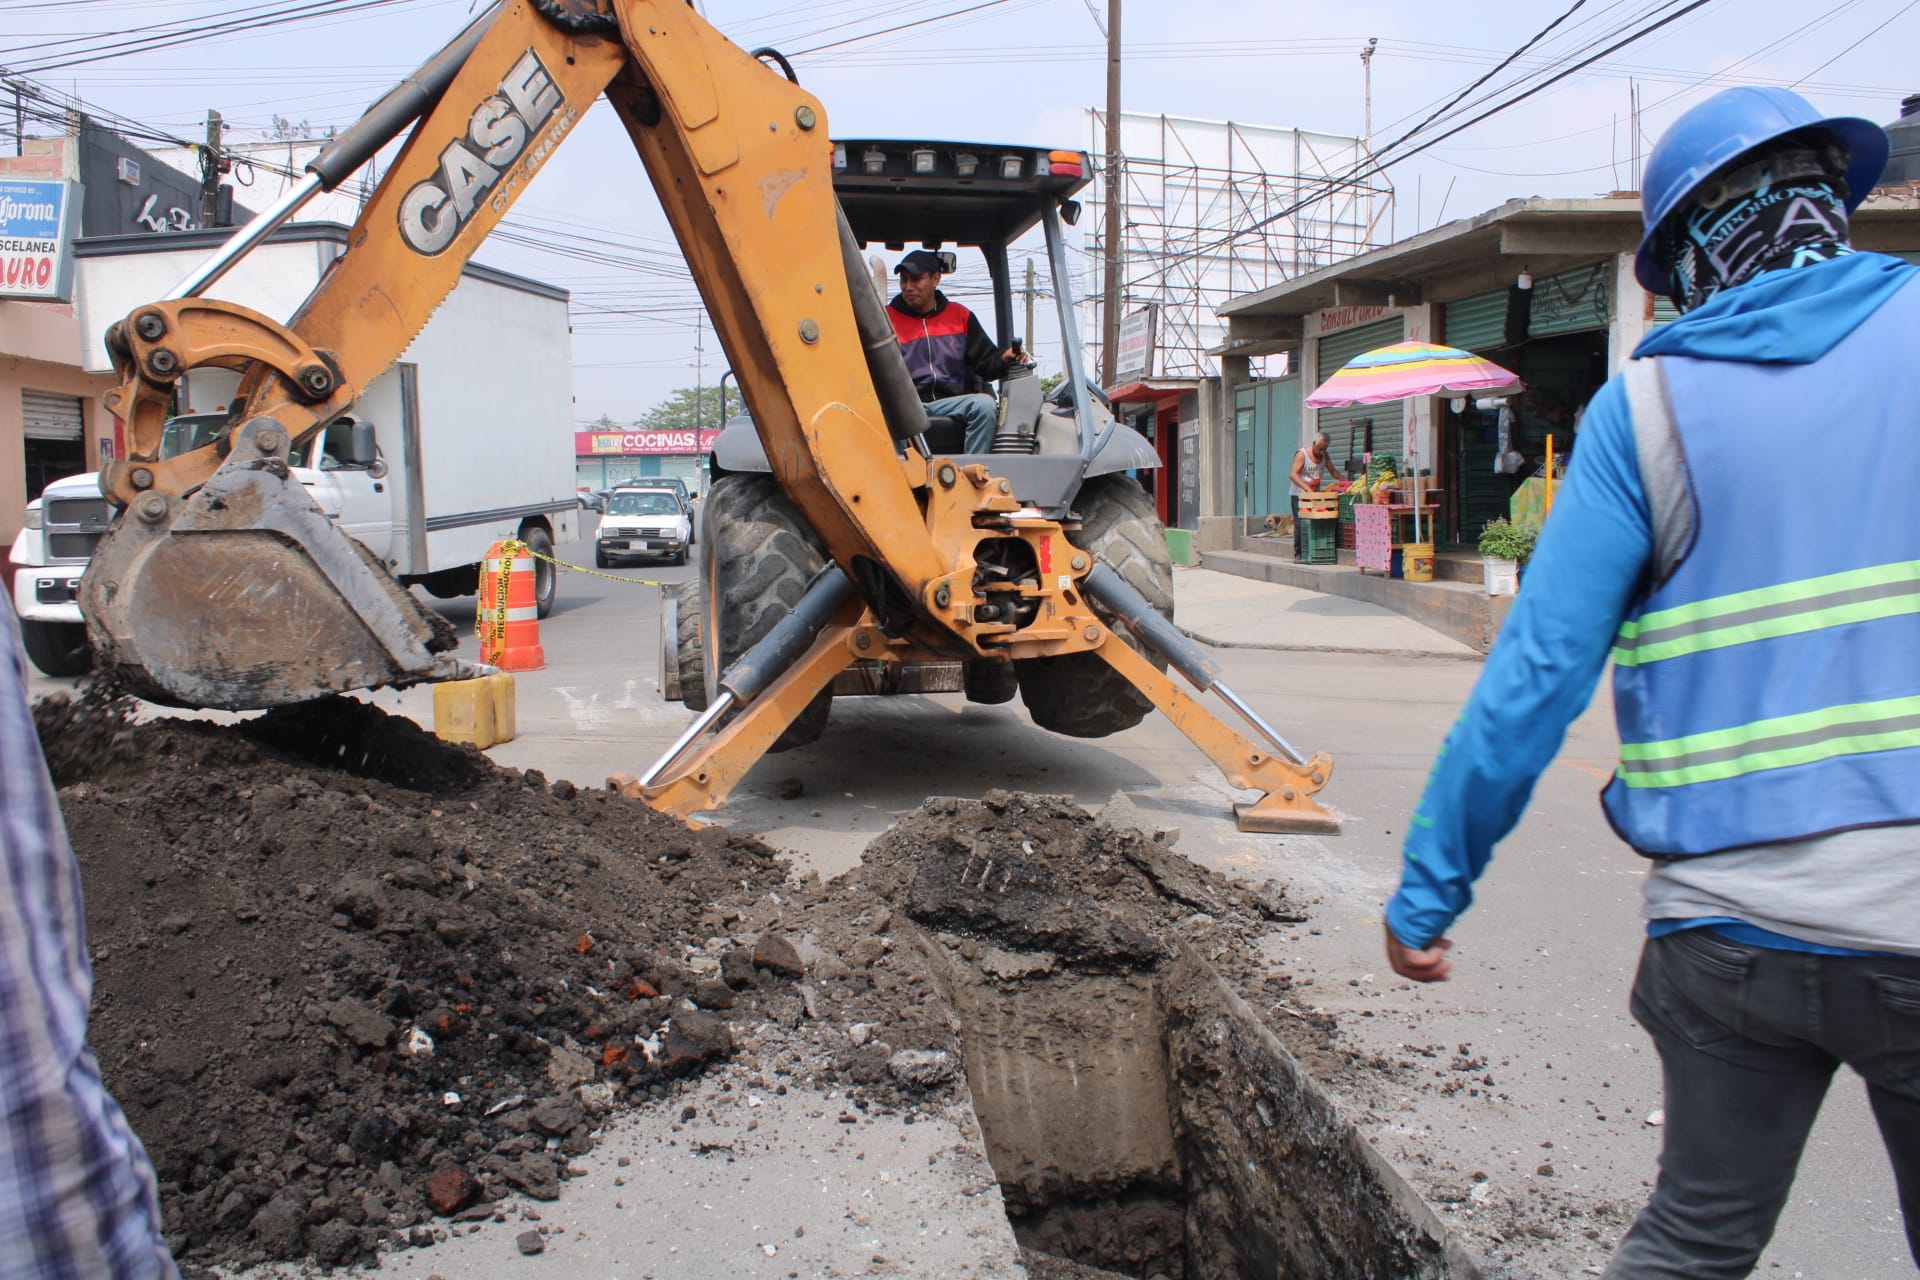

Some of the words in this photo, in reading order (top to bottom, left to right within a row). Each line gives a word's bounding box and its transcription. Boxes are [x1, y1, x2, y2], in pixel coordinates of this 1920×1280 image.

[397, 46, 565, 258] CASE
[0, 195, 54, 227] Corona
[624, 433, 696, 447] COCINAS
[497, 578, 505, 639] PRECAUCION
